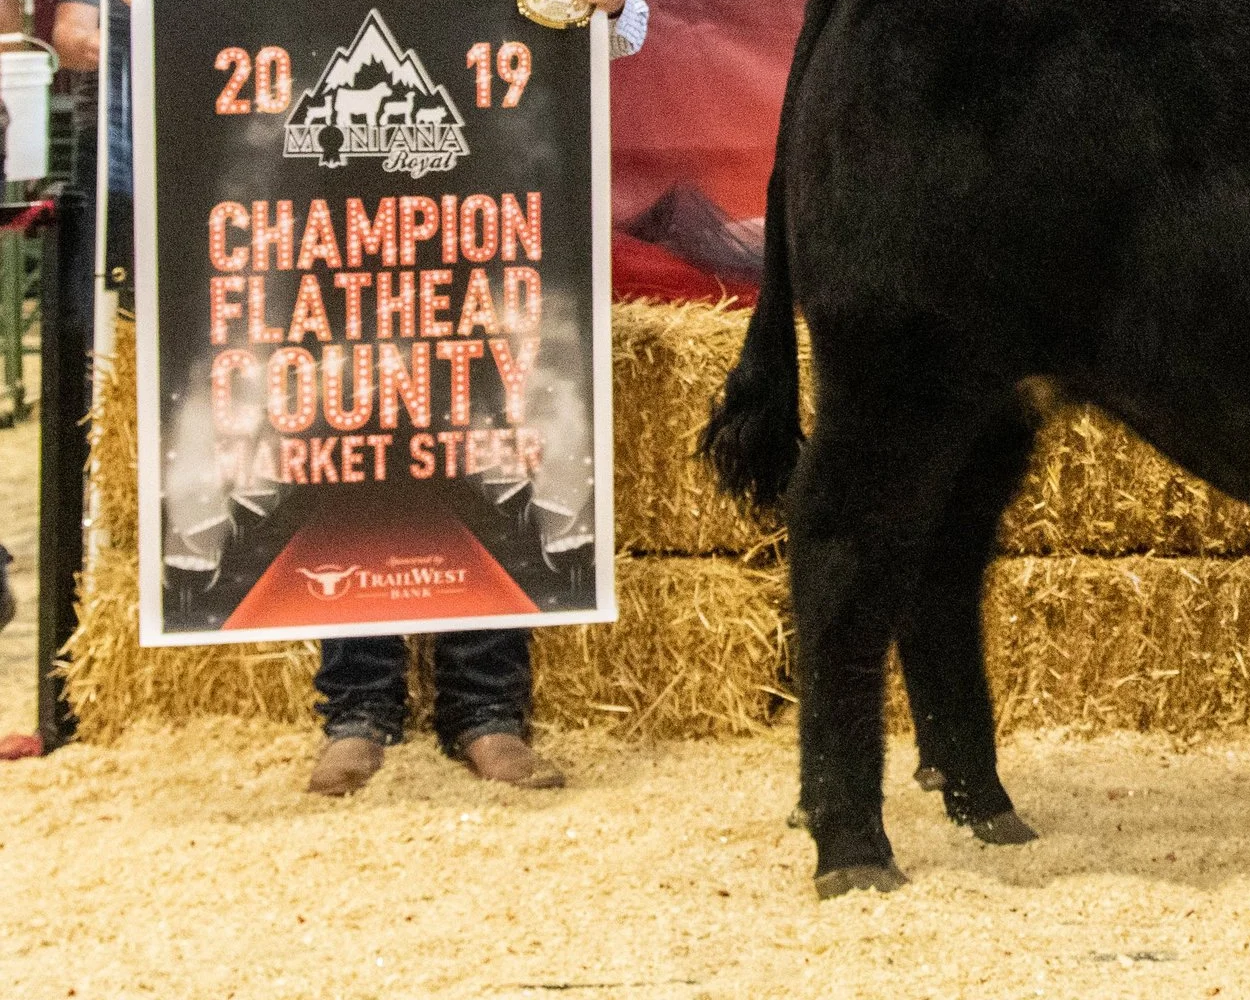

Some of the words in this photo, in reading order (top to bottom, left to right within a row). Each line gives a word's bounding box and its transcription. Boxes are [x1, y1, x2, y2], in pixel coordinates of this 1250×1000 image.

[214, 46, 292, 115] 20
[466, 41, 532, 109] 19
[284, 124, 466, 154] MONTANA
[382, 150, 457, 179] Royal
[208, 191, 542, 272] CHAMPION
[210, 266, 542, 345] FLATHEAD
[211, 337, 541, 435] COUNTY
[213, 433, 393, 485] MARKET
[409, 427, 545, 480] STEER
